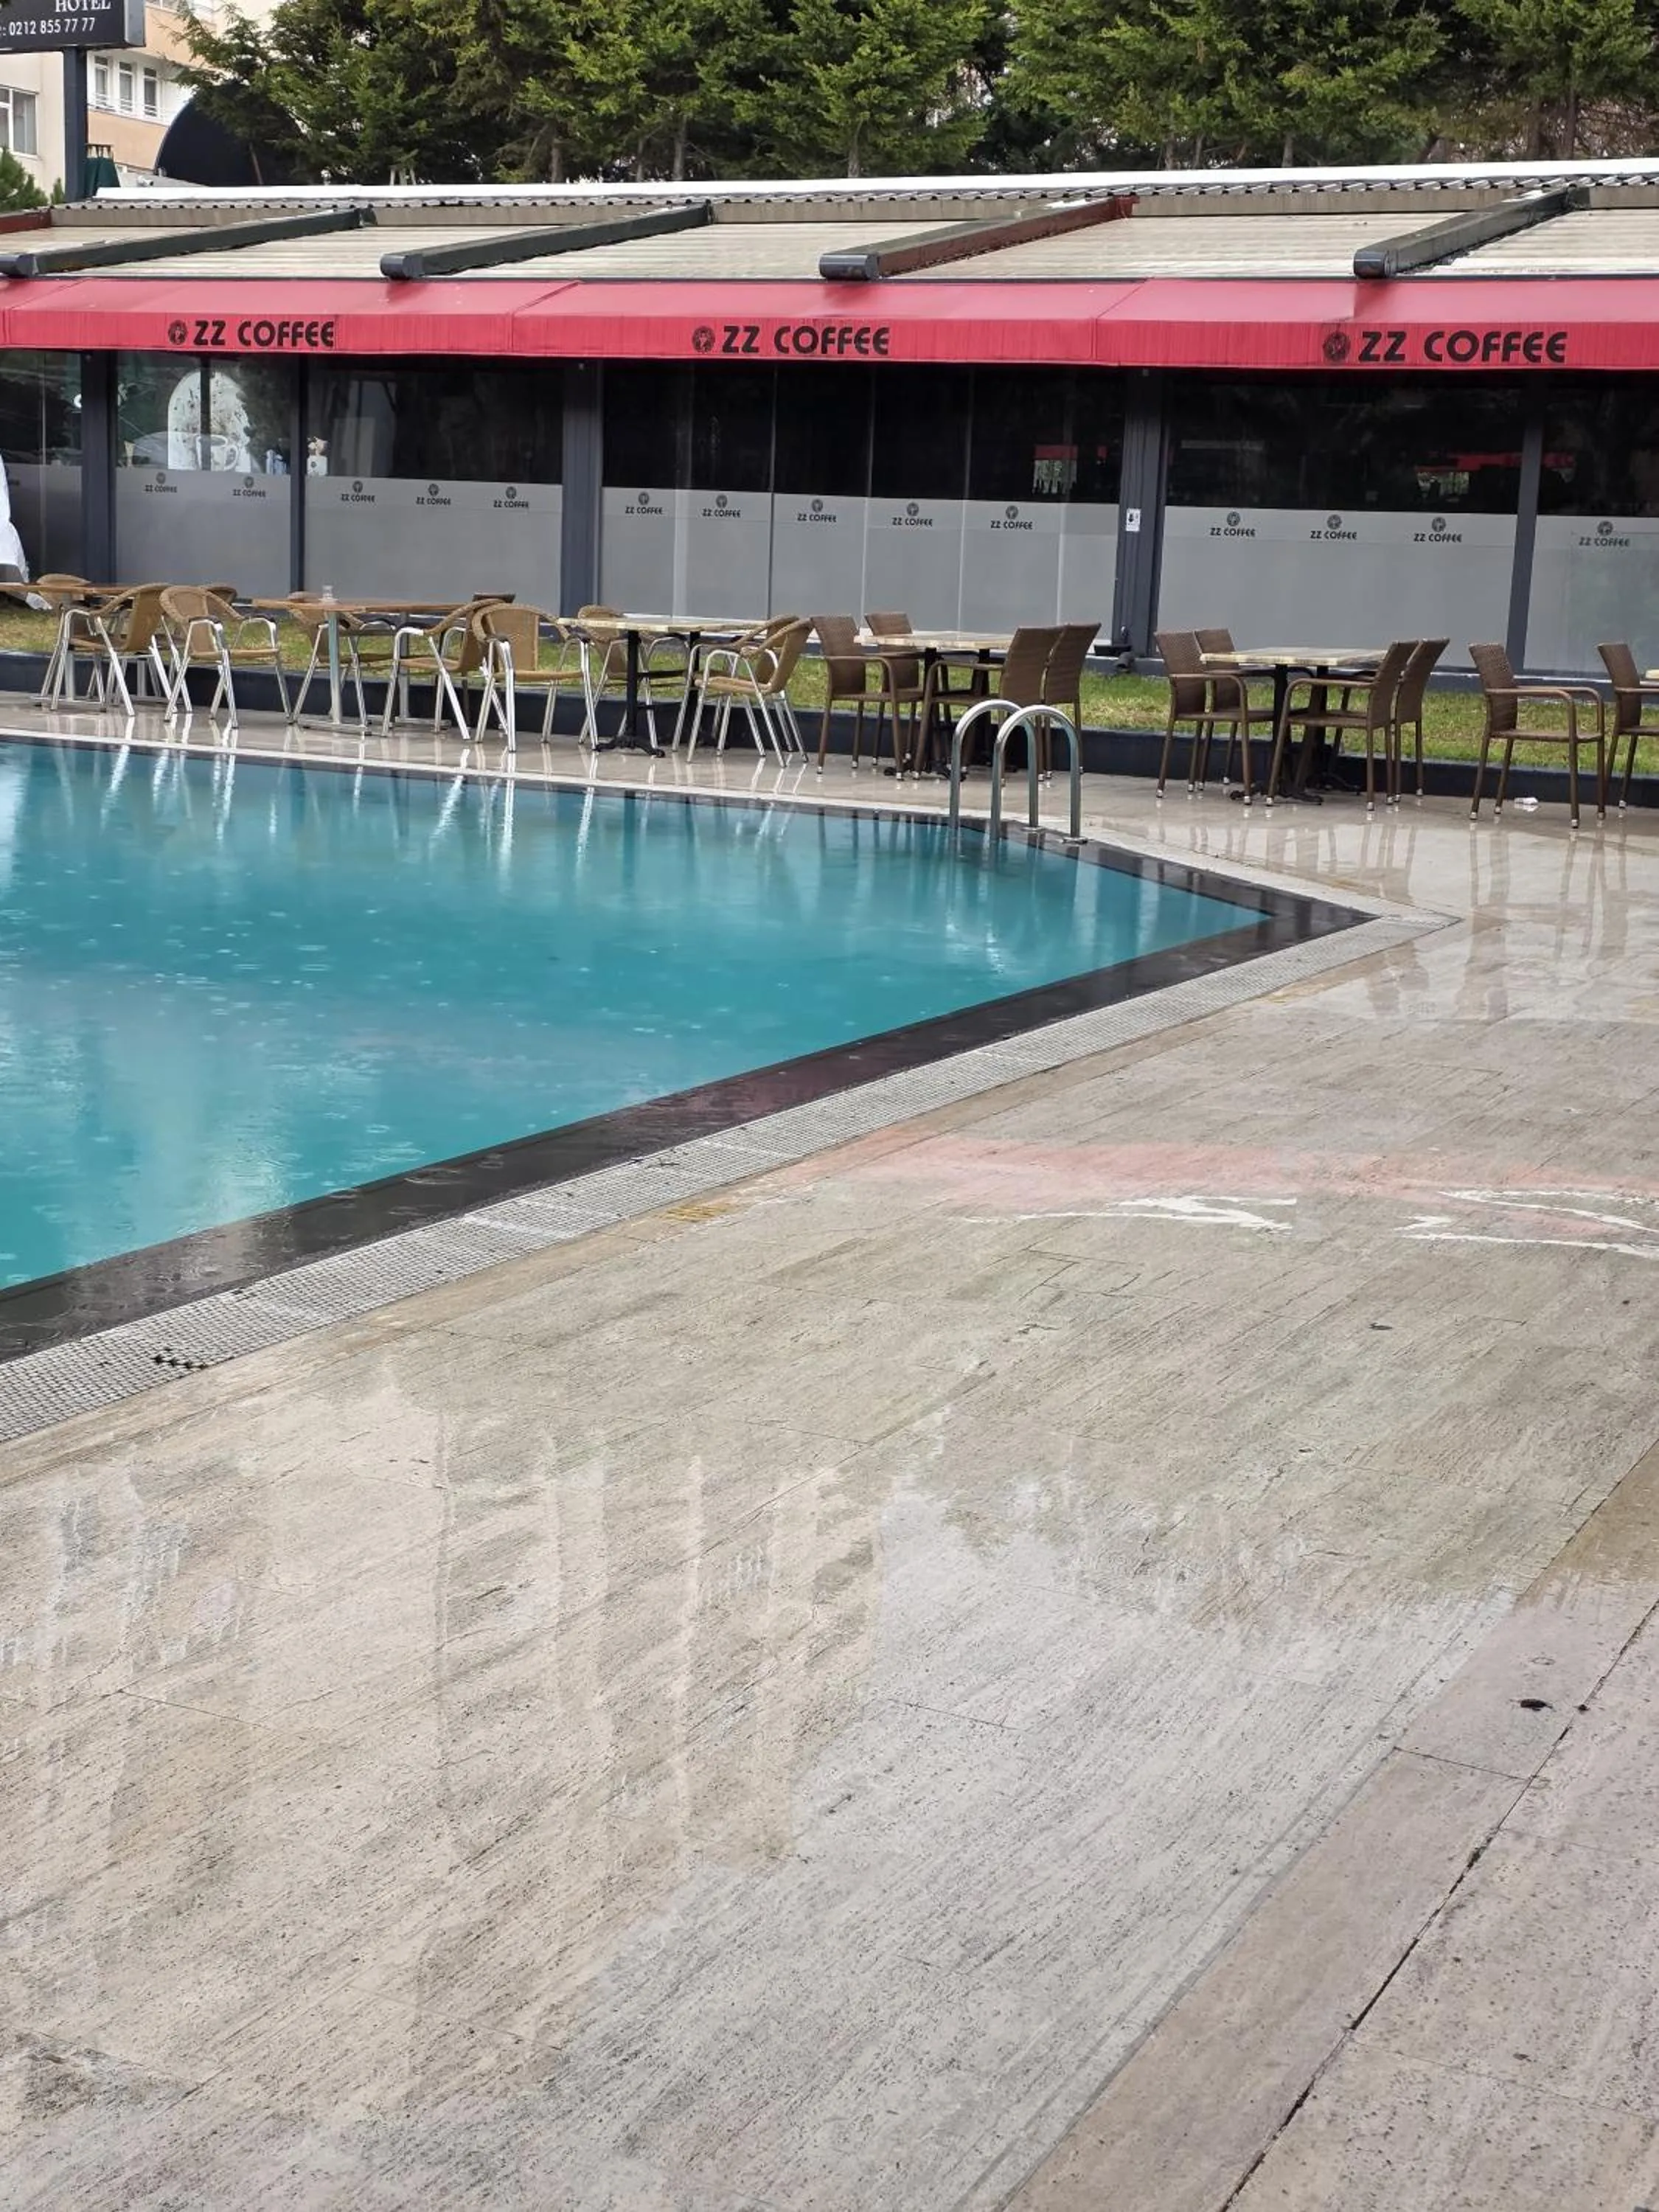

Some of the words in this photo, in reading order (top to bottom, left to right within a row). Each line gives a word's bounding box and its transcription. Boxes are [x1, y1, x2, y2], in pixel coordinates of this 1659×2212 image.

[55, 0, 111, 12] HOTEL
[9, 21, 36, 35] 0212
[40, 19, 61, 34] 855
[64, 18, 78, 33] 77
[82, 17, 95, 32] 77
[193, 321, 226, 346] ZZ
[237, 321, 334, 347] COFFEE
[722, 325, 759, 353] ZZ
[773, 326, 889, 355] COFFEE
[1358, 331, 1405, 361] ZZ
[1424, 331, 1568, 363] COFFEE
[637, 507, 663, 515] COFFEE
[702, 508, 712, 516] ZZ
[714, 508, 740, 518] COFFEE
[797, 512, 807, 521] ZZ
[809, 514, 837, 523] COFFEE
[892, 517, 902, 526] ZZ
[905, 518, 933, 527] COFFEE
[990, 520, 1001, 529] ZZ
[1004, 521, 1033, 530] COFFEE
[1210, 528, 1222, 536] ZZ
[1224, 528, 1255, 537] COFFEE
[1310, 530, 1321, 539] ZZ
[1324, 530, 1357, 540] COFFEE
[1413, 533, 1426, 542] ZZ
[1428, 534, 1462, 543] COFFEE
